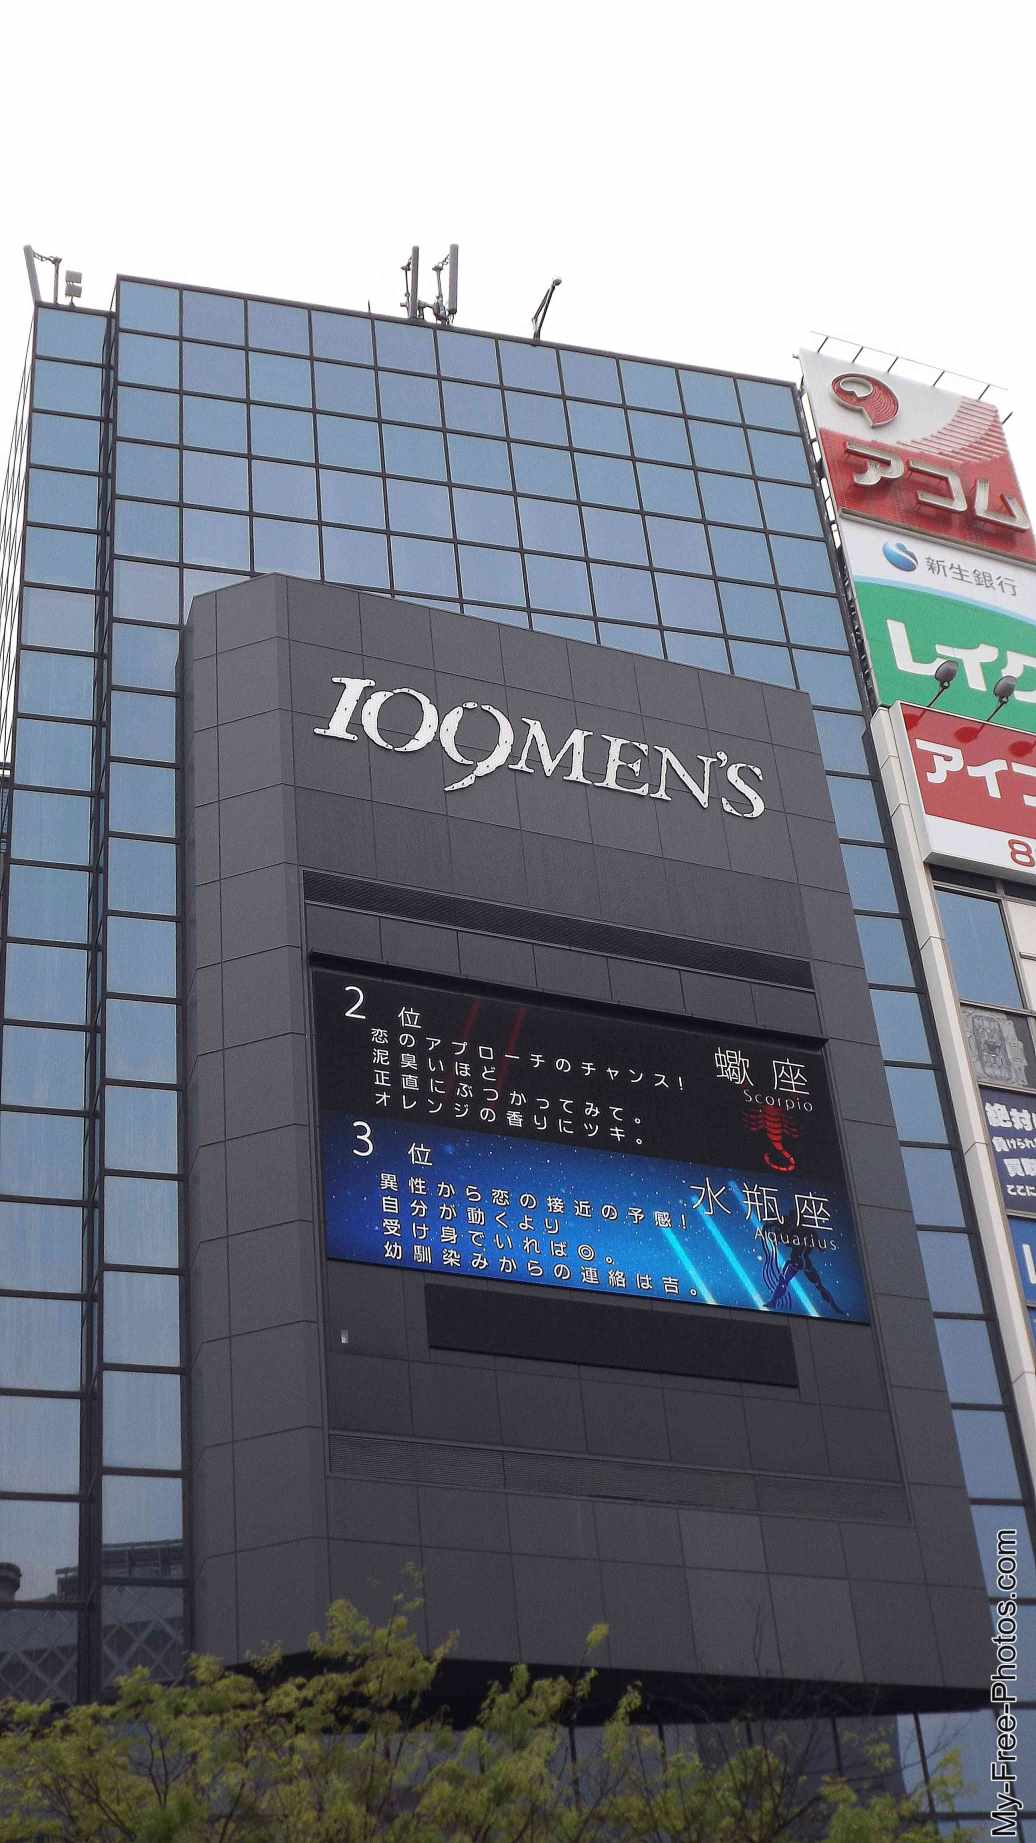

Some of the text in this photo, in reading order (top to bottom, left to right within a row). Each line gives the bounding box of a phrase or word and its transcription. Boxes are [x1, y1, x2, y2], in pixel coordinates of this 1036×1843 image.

[845, 441, 1031, 530] アコム
[925, 556, 1017, 596] 新生銀行
[372, 1048, 497, 1081] 泥臭いほど
[714, 1046, 811, 1096] 蠍座
[374, 1069, 642, 1124] 正直にぶつかってみて。
[375, 1091, 644, 1145] オレンジの香りにツキ。
[743, 1088, 814, 1112] Scorpio
[381, 1195, 560, 1235] 自分が動くより
[689, 1176, 833, 1231] 水瓶座
[754, 1228, 838, 1252] Aquarius
[384, 1240, 698, 1297] 幼馴染みからの連絡は吉。
